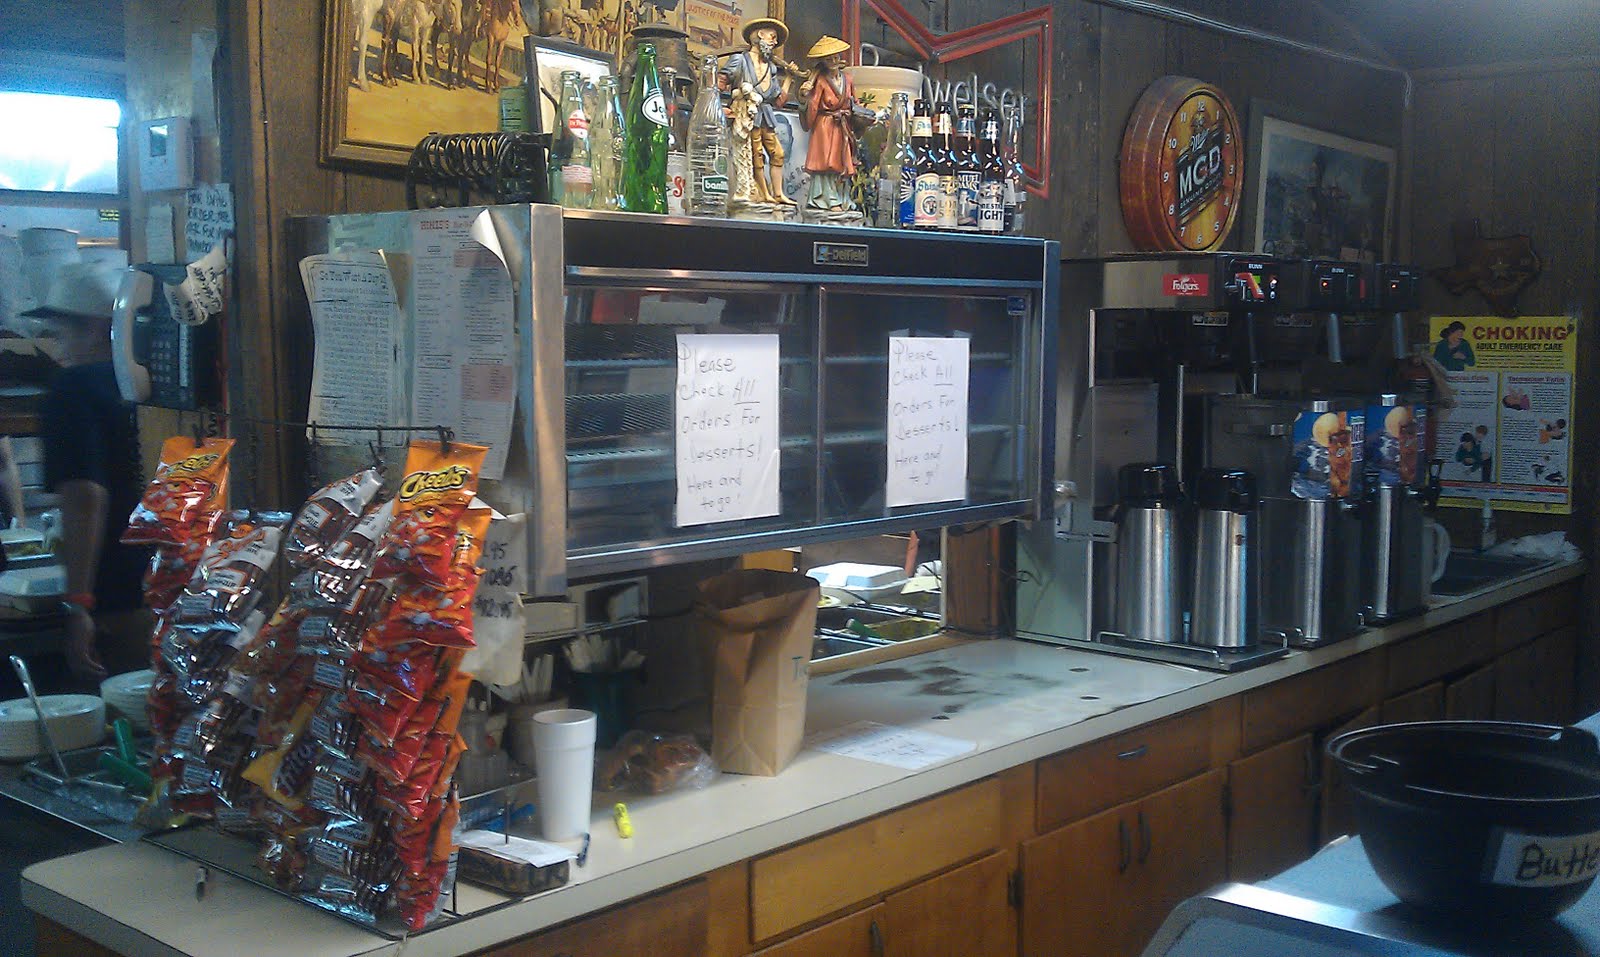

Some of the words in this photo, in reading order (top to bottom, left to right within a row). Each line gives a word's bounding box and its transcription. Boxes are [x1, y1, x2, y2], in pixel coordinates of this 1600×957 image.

[1197, 101, 1204, 111] 12
[1180, 112, 1187, 122] 11
[1168, 138, 1177, 148] 10
[1225, 134, 1231, 143] 2
[1163, 172, 1169, 182] 9
[1228, 165, 1234, 175] 3
[1168, 204, 1175, 215] 8
[1472, 325, 1568, 341] CHOKING
[893, 339, 937, 365] Please
[1475, 342, 1497, 351] ADULT
[1499, 342, 1541, 351] EMERGENCY
[1543, 343, 1564, 351] CARE
[678, 342, 736, 375] Please
[892, 364, 928, 386] Check
[680, 380, 726, 401] Check
[893, 399, 932, 417] Orders
[940, 394, 955, 408] For
[682, 410, 731, 434] Orders
[742, 407, 761, 426] For
[895, 414, 958, 441] Desserts!
[895, 450, 919, 468] Here
[924, 443, 943, 461] and
[399, 463, 470, 501] Cheetos
[686, 474, 713, 494] Here
[719, 468, 742, 487] and
